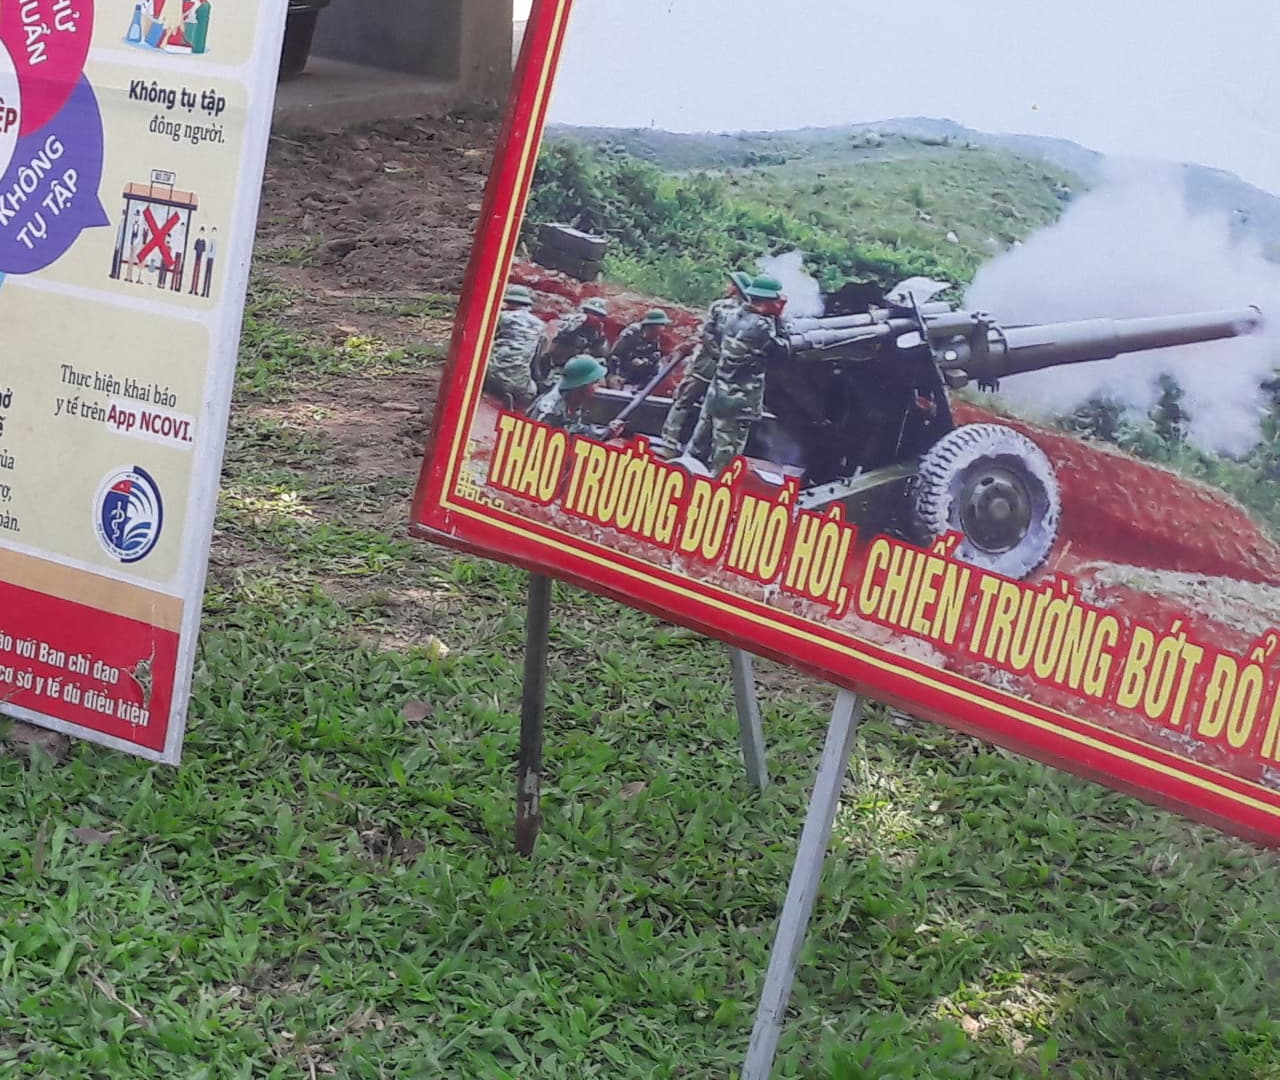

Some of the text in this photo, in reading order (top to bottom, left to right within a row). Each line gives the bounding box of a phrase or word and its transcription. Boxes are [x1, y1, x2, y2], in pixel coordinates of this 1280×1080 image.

[129, 80, 225, 117] Không tụ tập
[16, 169, 78, 250] TỤ TẬP
[94, 371, 120, 397] hiện
[124, 377, 151, 401] khai
[154, 384, 176, 408] báo
[54, 396, 192, 442] y tế trên App NCOVI.
[491, 415, 566, 503] THAO
[566, 440, 683, 543] TRƯỜNG
[680, 459, 742, 560] ĐỔ
[729, 481, 795, 580] MỒ
[786, 507, 853, 616] HÔI,
[858, 536, 971, 646] CHIẾN
[969, 578, 1119, 699] TRƯỜNG
[1117, 619, 1204, 726] BỚT
[1198, 633, 1278, 749] ĐỔ
